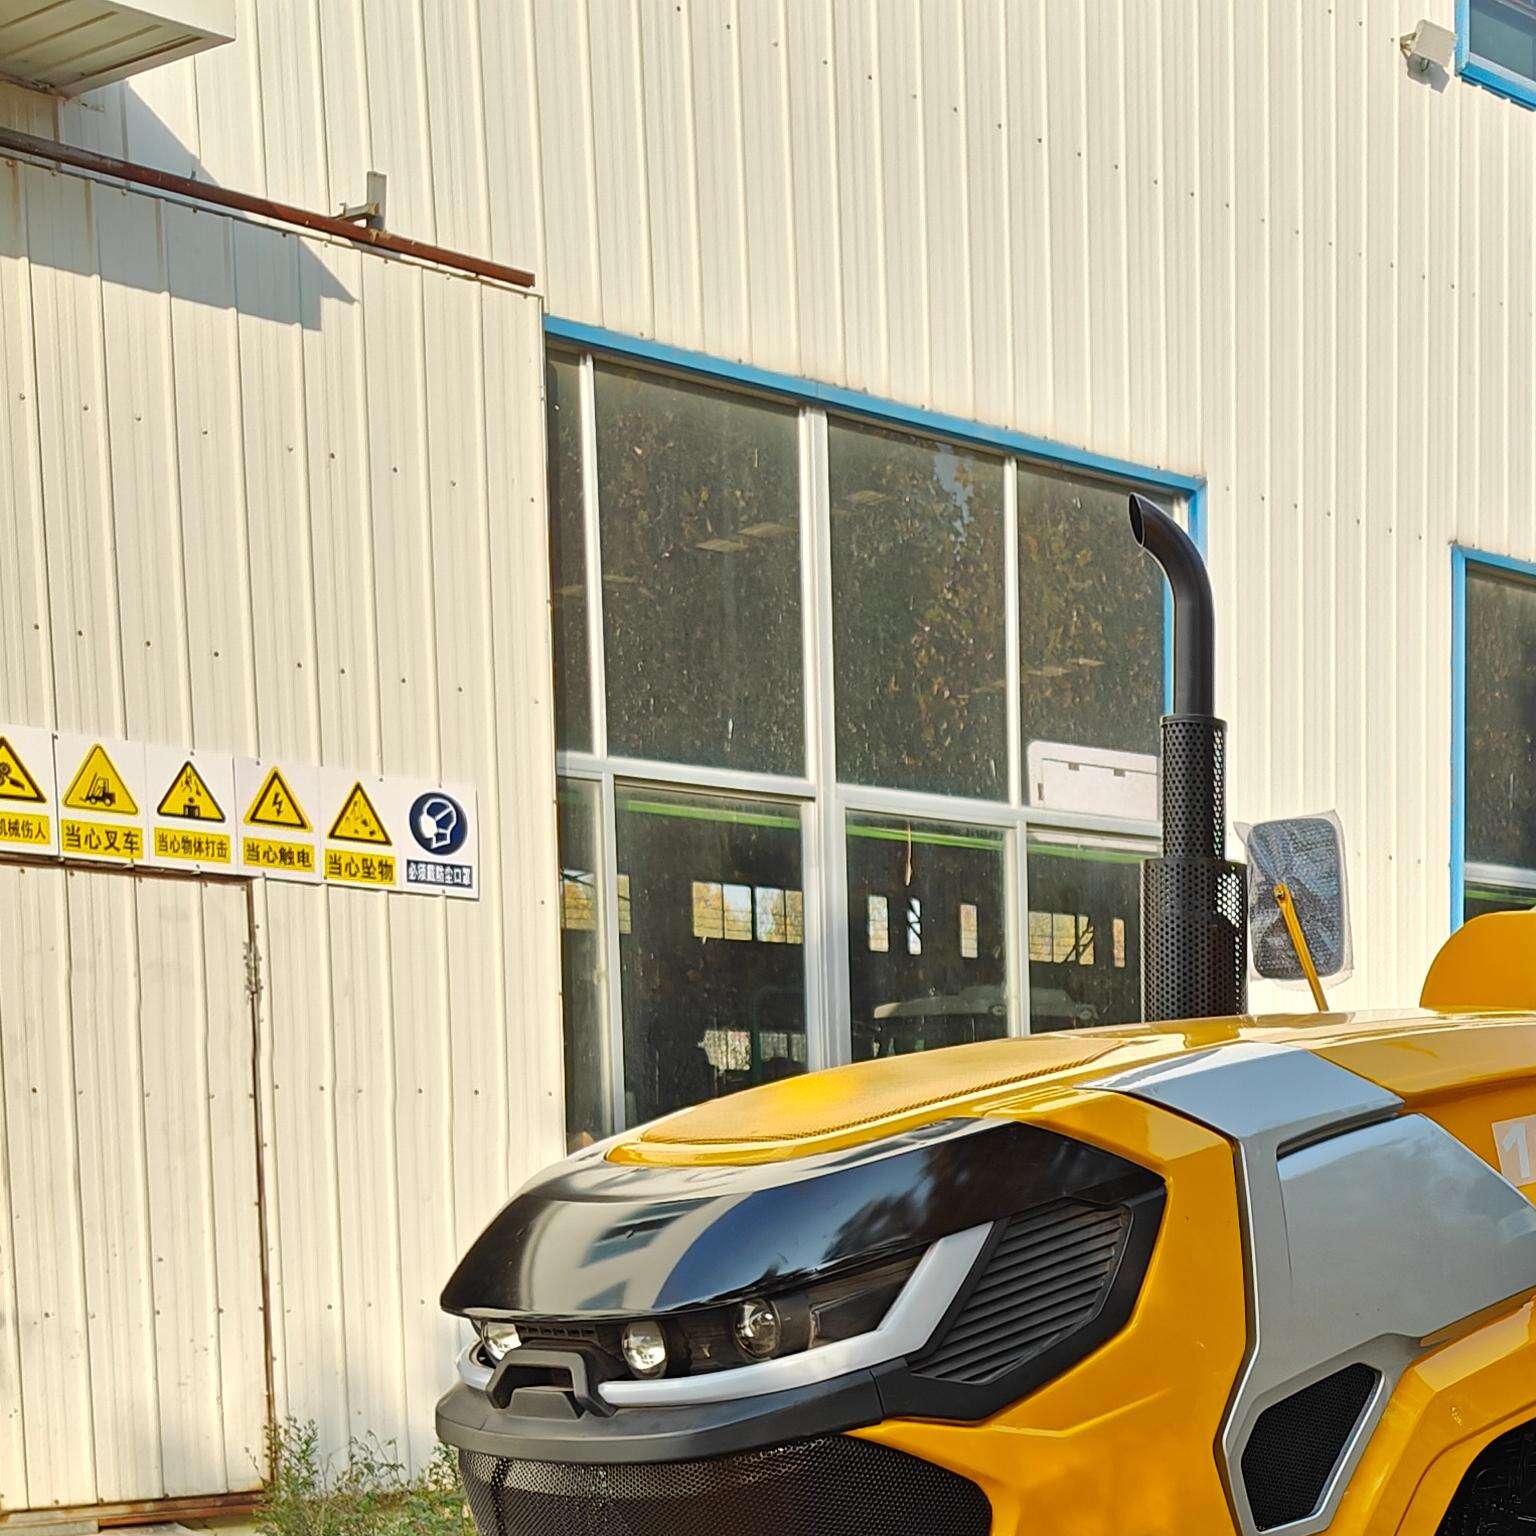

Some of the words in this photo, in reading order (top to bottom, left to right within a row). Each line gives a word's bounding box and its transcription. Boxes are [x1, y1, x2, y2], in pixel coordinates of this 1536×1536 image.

[65, 824, 140, 853] 当心叉车
[158, 833, 228, 859] 当心物体打击
[246, 842, 312, 868] 当心触电
[328, 853, 394, 882] 当心坠物
[408, 862, 472, 886] 必须戴防尘口罩
